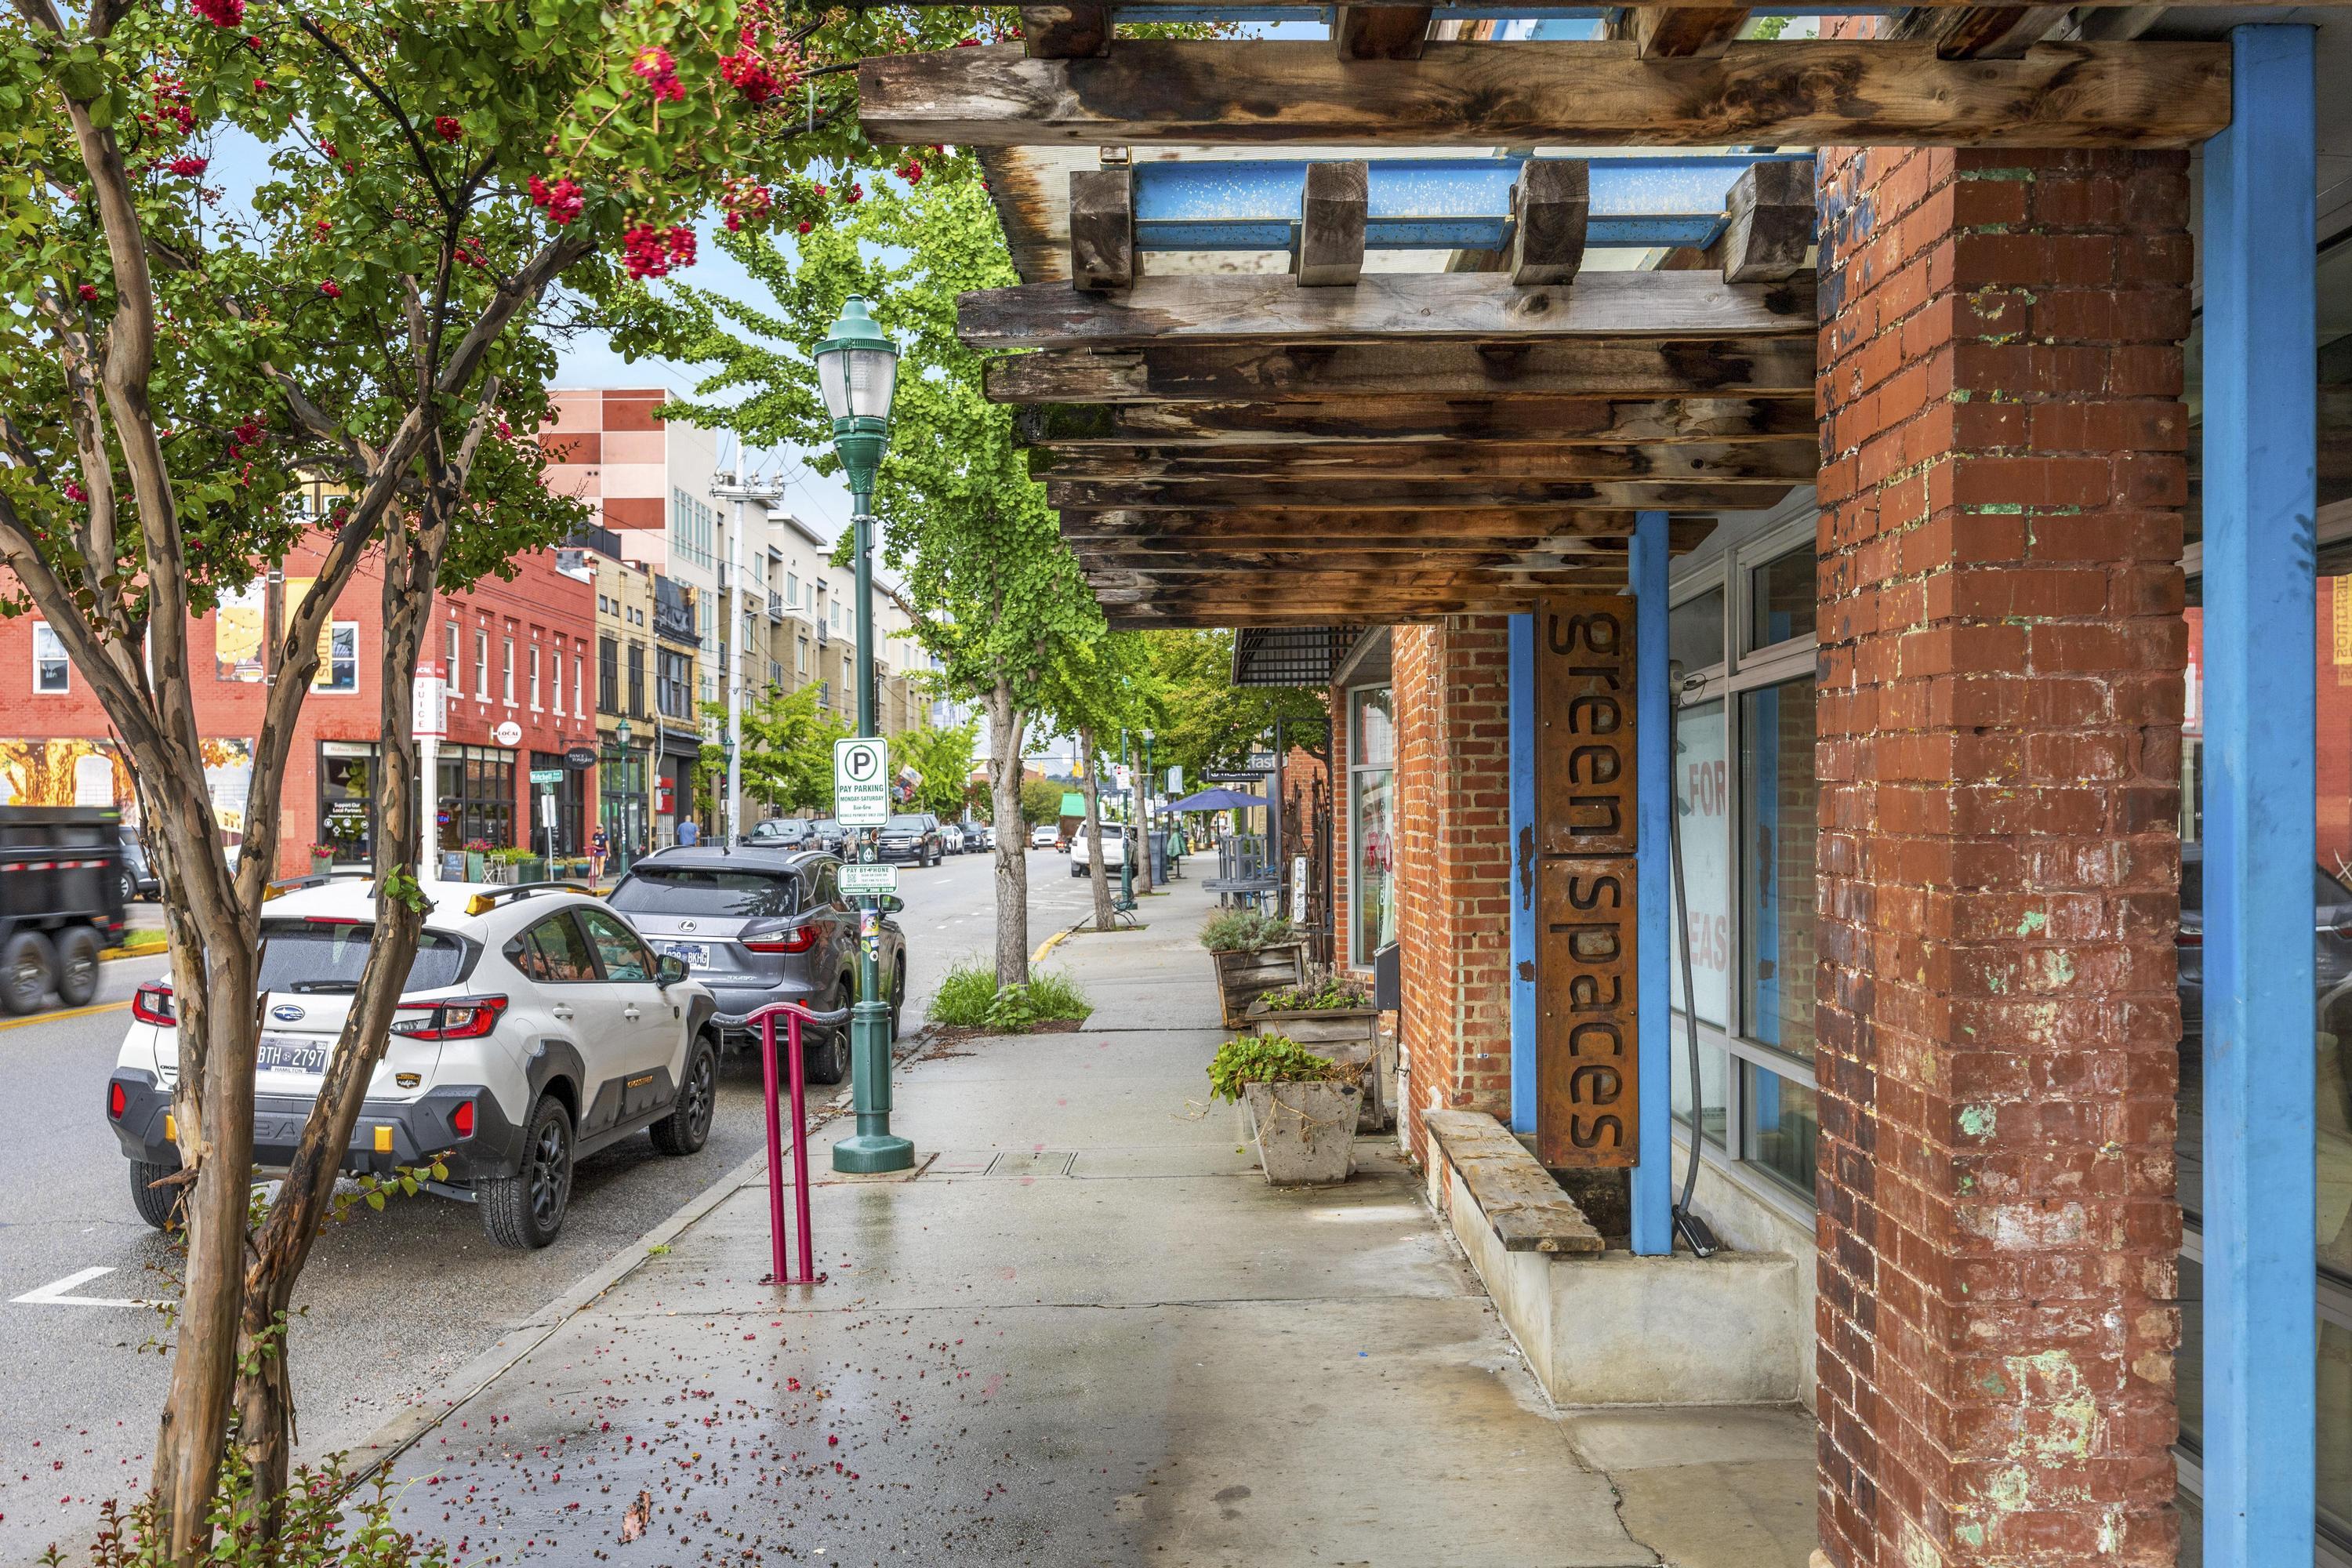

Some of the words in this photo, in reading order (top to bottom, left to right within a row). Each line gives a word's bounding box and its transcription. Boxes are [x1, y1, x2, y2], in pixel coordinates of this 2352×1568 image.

[1548, 612, 1622, 837] green
[854, 752, 870, 775] P
[532, 772, 553, 781] Mitchell
[1678, 910, 1726, 973] EAS
[688, 952, 707, 964] BKHG
[1548, 876, 1623, 1149] spaces
[257, 1046, 281, 1065] BTH
[292, 1048, 325, 1067] 2797
